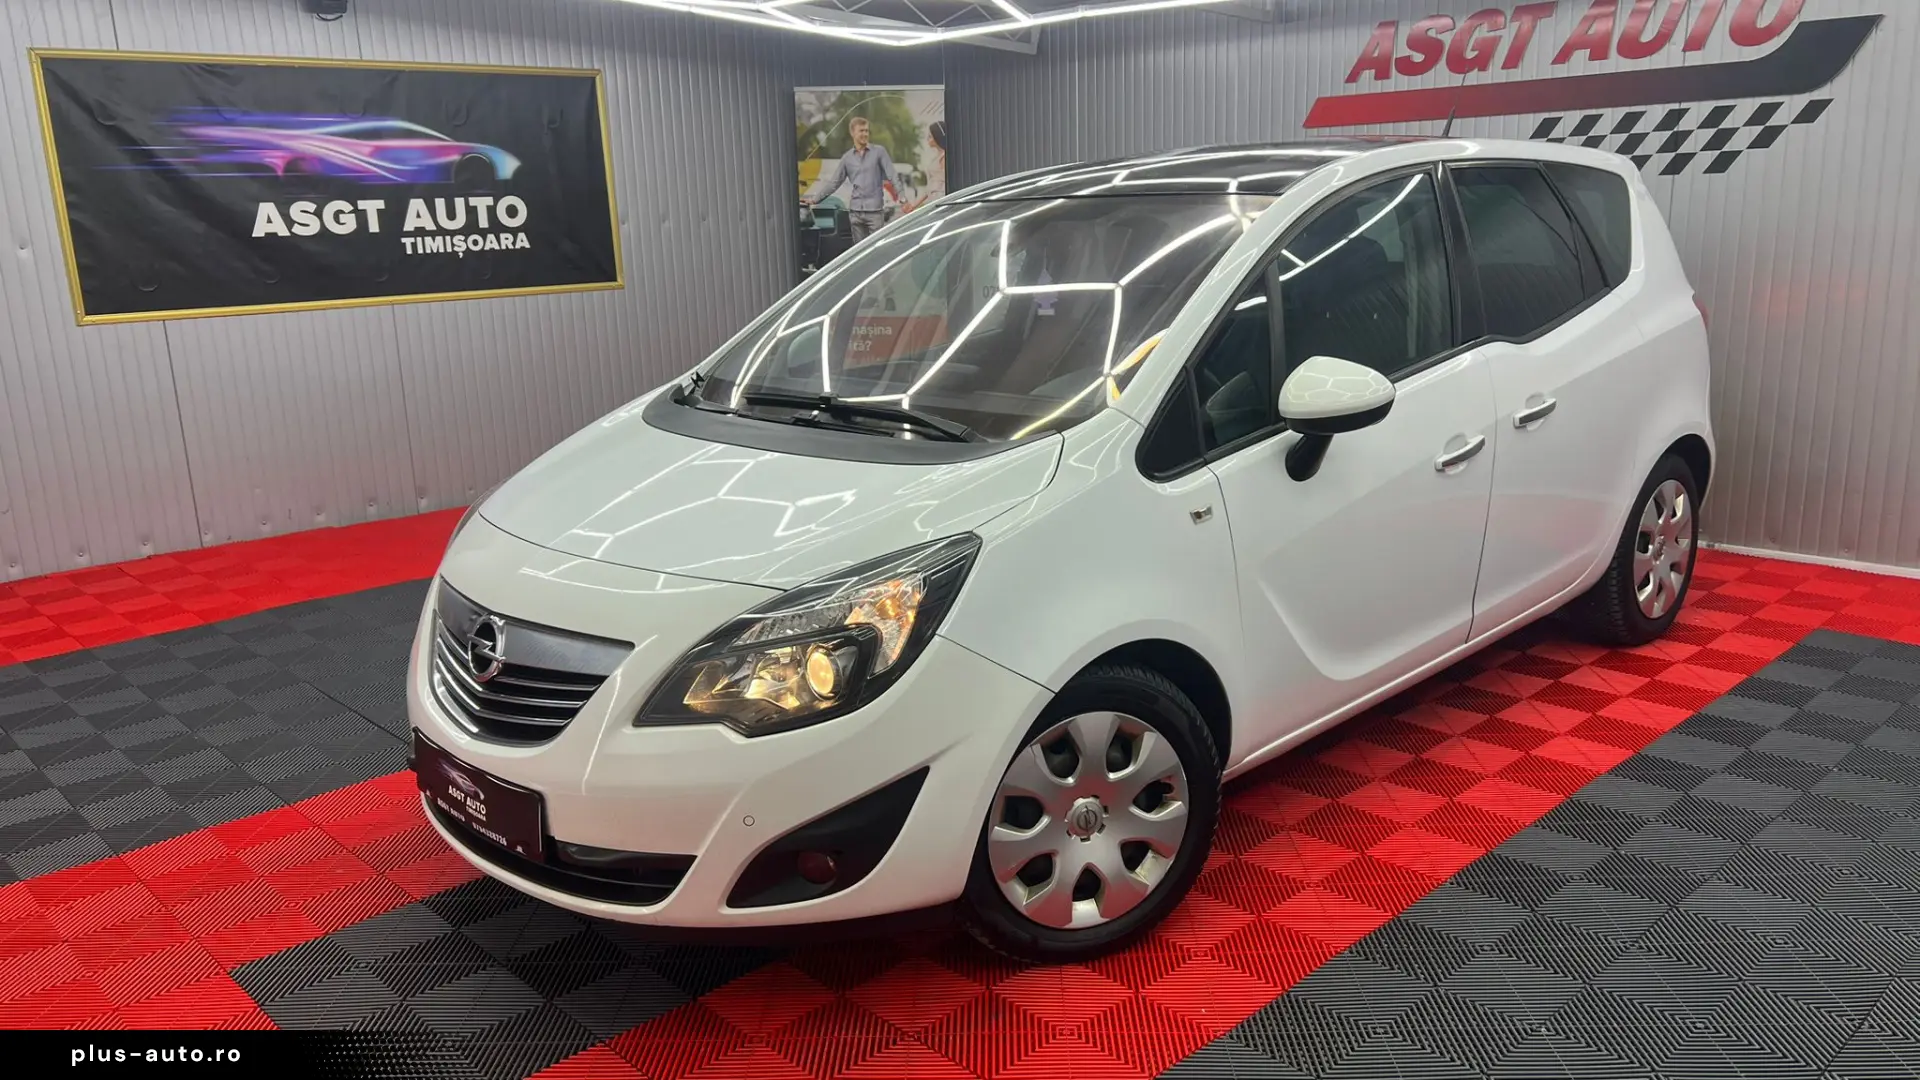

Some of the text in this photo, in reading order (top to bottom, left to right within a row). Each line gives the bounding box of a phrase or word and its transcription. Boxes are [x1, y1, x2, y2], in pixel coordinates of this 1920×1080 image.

[1345, 0, 1802, 84] ASGT AUTO
[251, 195, 528, 237] ASGT AUTO
[401, 232, 531, 258] TIMIȘOARA
[448, 784, 465, 802] ASGT
[466, 796, 487, 815] AUTO
